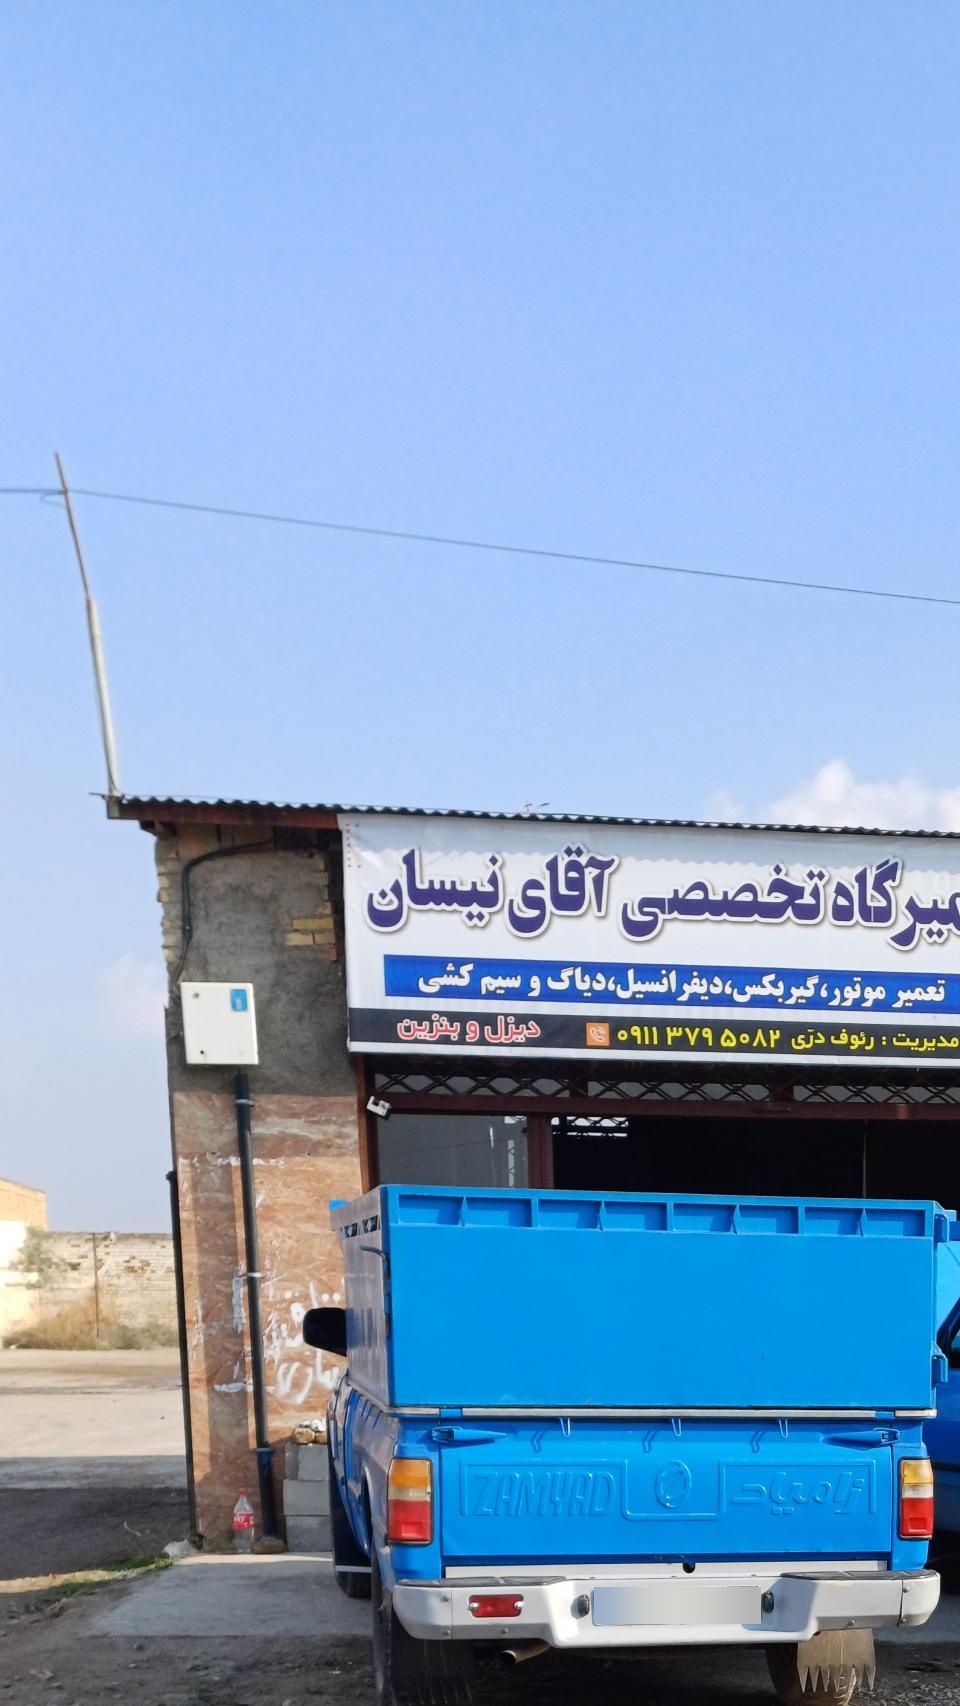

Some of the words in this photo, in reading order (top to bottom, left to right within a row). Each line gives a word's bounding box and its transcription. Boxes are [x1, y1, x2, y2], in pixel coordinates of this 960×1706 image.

[367, 848, 501, 928] نیسان
[507, 845, 616, 934] آقای
[621, 863, 826, 938] تخصصی
[418, 962, 474, 994] کشی
[480, 972, 522, 995] سیم
[527, 974, 541, 997] و
[891, 979, 946, 1008] تعمیر
[396, 1013, 461, 1041] بنزین
[465, 1020, 480, 1042] و
[483, 1015, 541, 1043] دیزل
[665, 1026, 713, 1047] ۳۷۹
[719, 1028, 781, 1049] ۵۰۸۲
[830, 1028, 875, 1050] رئوف
[892, 1032, 960, 1052] مدیریت
[472, 1471, 615, 1517] ZAMYAD
[729, 1471, 865, 1515] زامیاد
